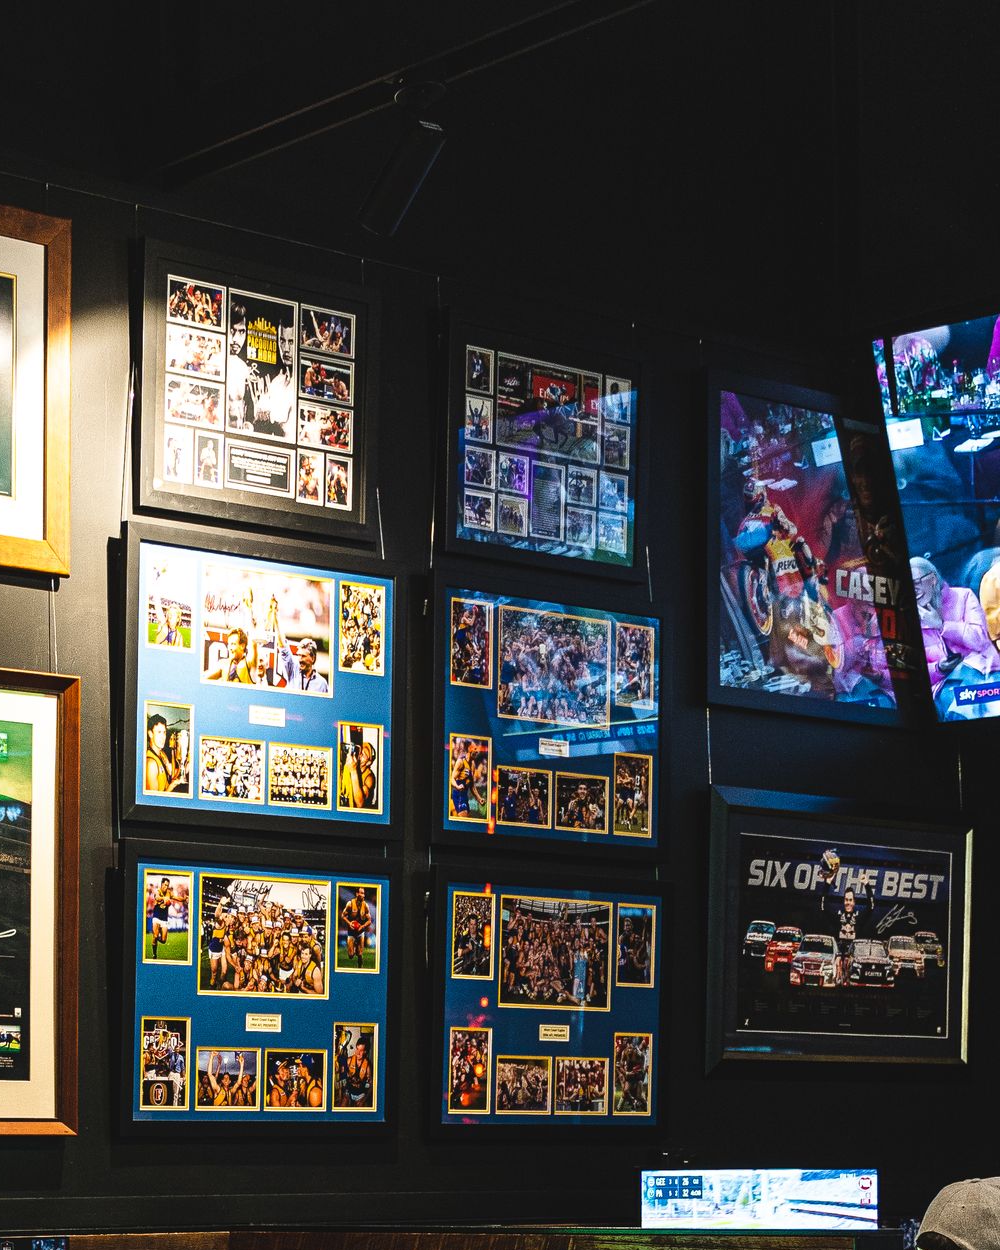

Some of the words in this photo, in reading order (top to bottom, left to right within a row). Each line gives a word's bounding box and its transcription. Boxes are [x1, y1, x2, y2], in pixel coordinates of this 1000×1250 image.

[247, 335, 277, 353] PACQUIAO
[835, 569, 900, 606] CASEY
[959, 688, 977, 701] sky
[976, 688, 1000, 698] SPOR
[748, 859, 791, 888] SIX
[882, 872, 944, 901] BEST
